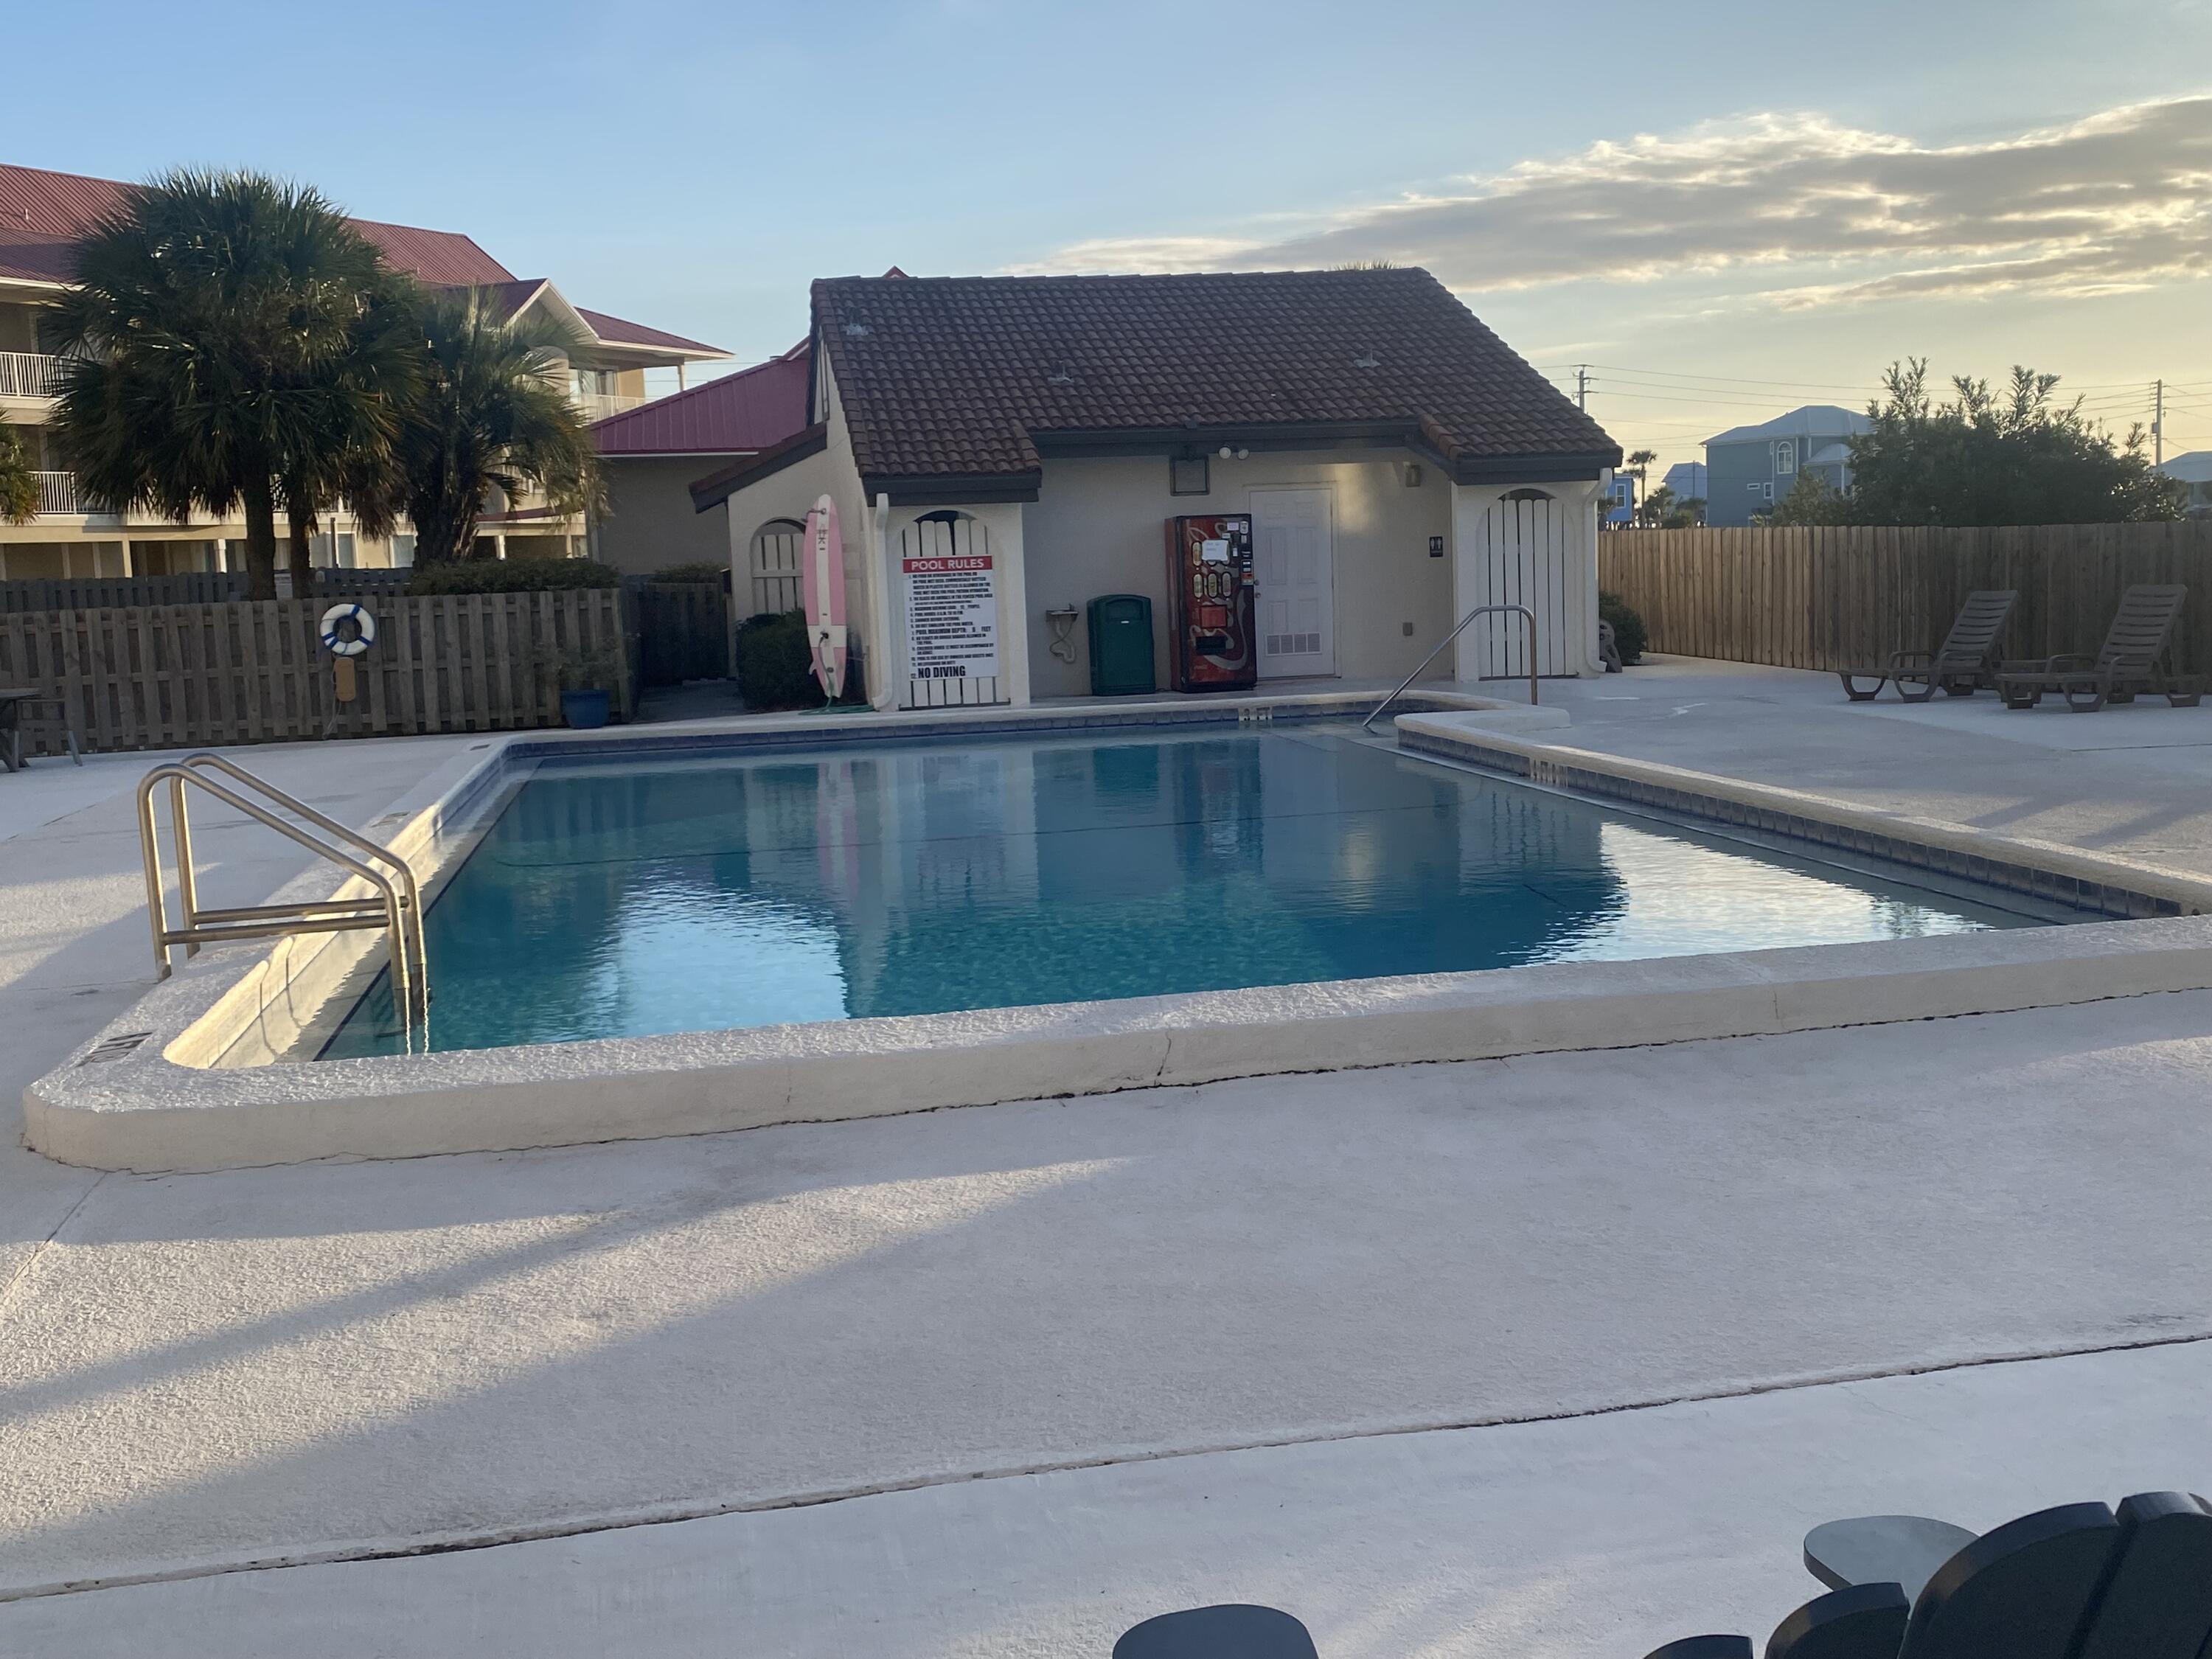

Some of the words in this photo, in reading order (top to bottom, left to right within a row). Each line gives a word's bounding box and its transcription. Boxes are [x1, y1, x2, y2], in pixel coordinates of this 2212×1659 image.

[911, 560, 945, 571] POOL
[947, 559, 984, 569] RULES
[918, 667, 931, 678] NO
[933, 666, 966, 678] DIVING
